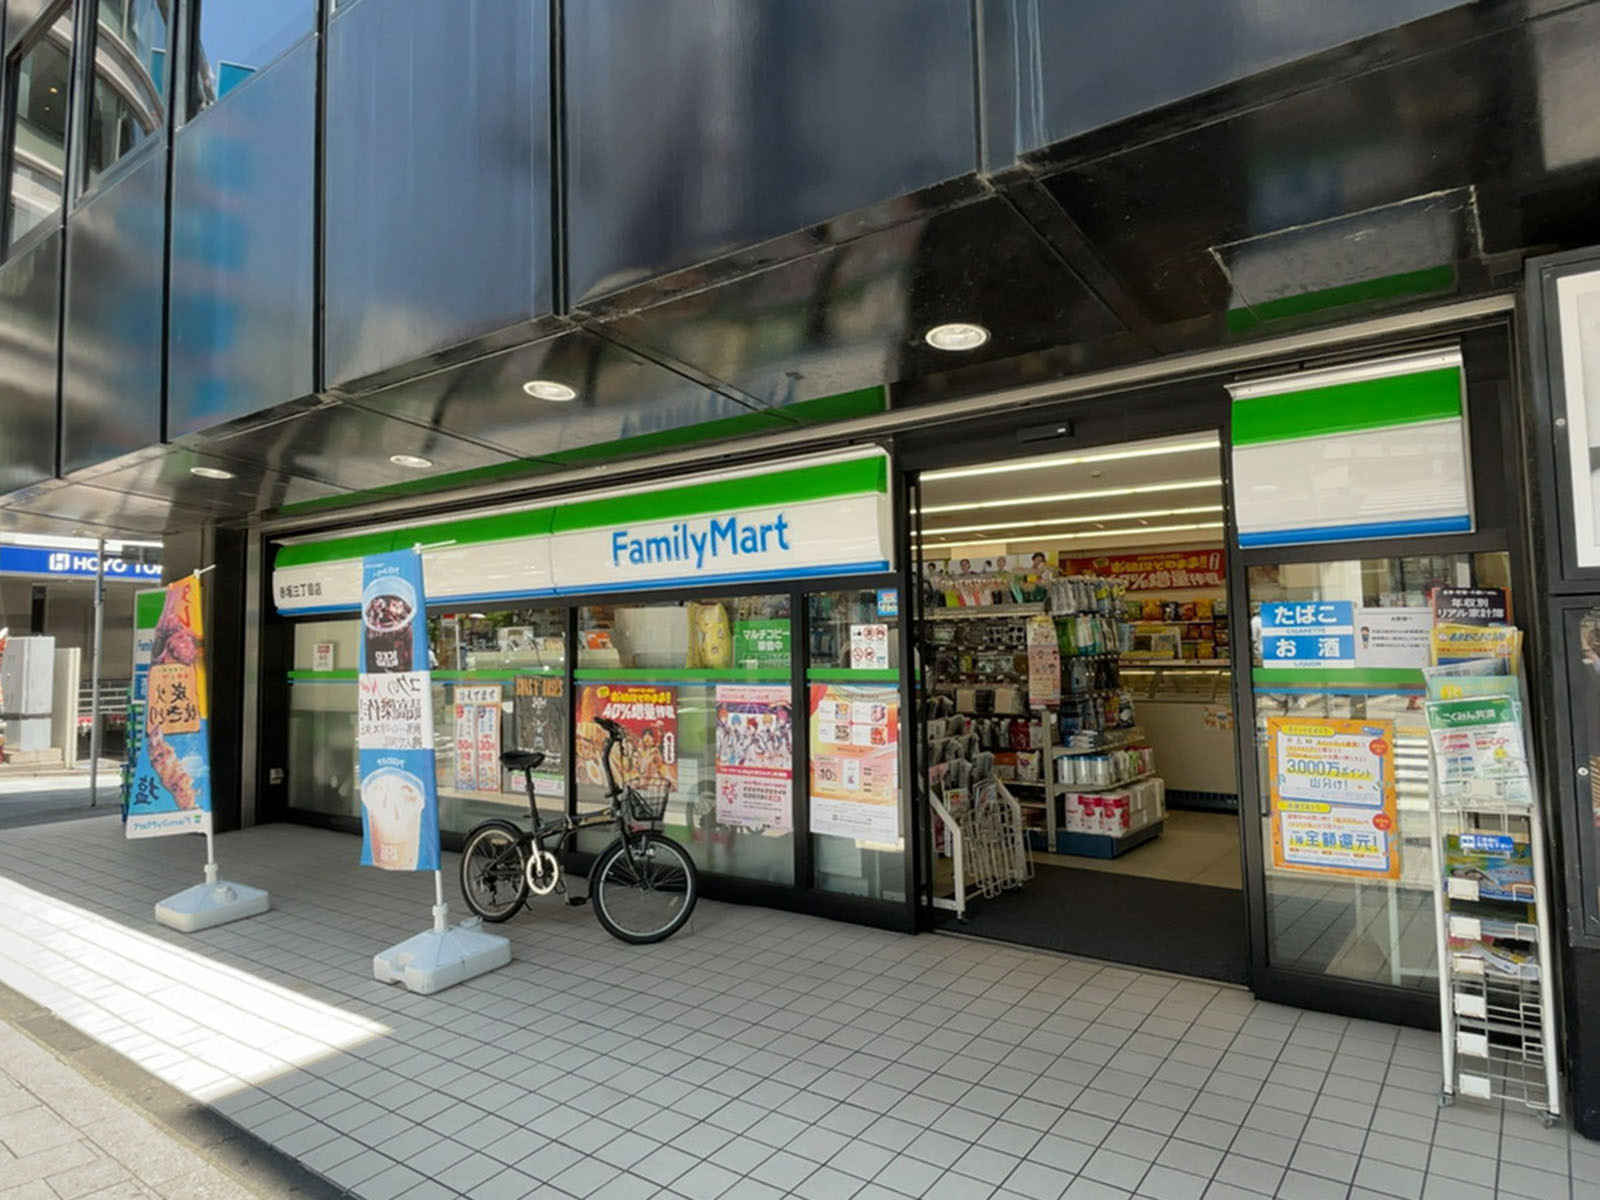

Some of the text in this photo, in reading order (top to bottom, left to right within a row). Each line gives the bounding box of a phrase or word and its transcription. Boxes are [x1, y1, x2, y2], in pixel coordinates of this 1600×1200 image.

[612, 513, 790, 570] FamilyMart
[73, 556, 126, 573] HOYO
[1451, 597, 1490, 609] 年収別
[1274, 605, 1338, 625] たばこ
[743, 628, 791, 640] マルチコピー
[1287, 759, 1371, 778] 3000万ポイント
